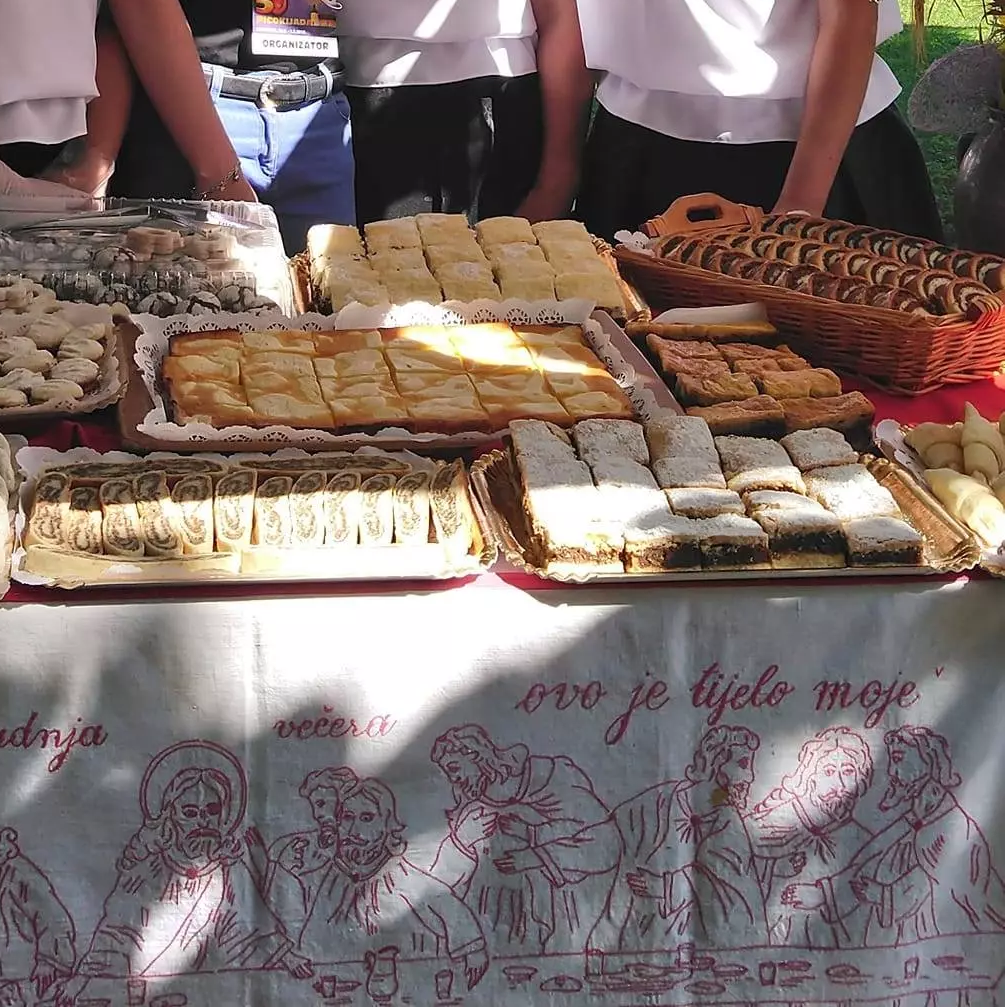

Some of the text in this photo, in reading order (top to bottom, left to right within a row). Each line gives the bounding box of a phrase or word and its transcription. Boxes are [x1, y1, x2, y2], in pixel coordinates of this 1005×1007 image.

[262, 39, 329, 51] ORGANIZATOR
[515, 661, 922, 746] ovo je tijelo moje
[273, 704, 398, 739] večera
